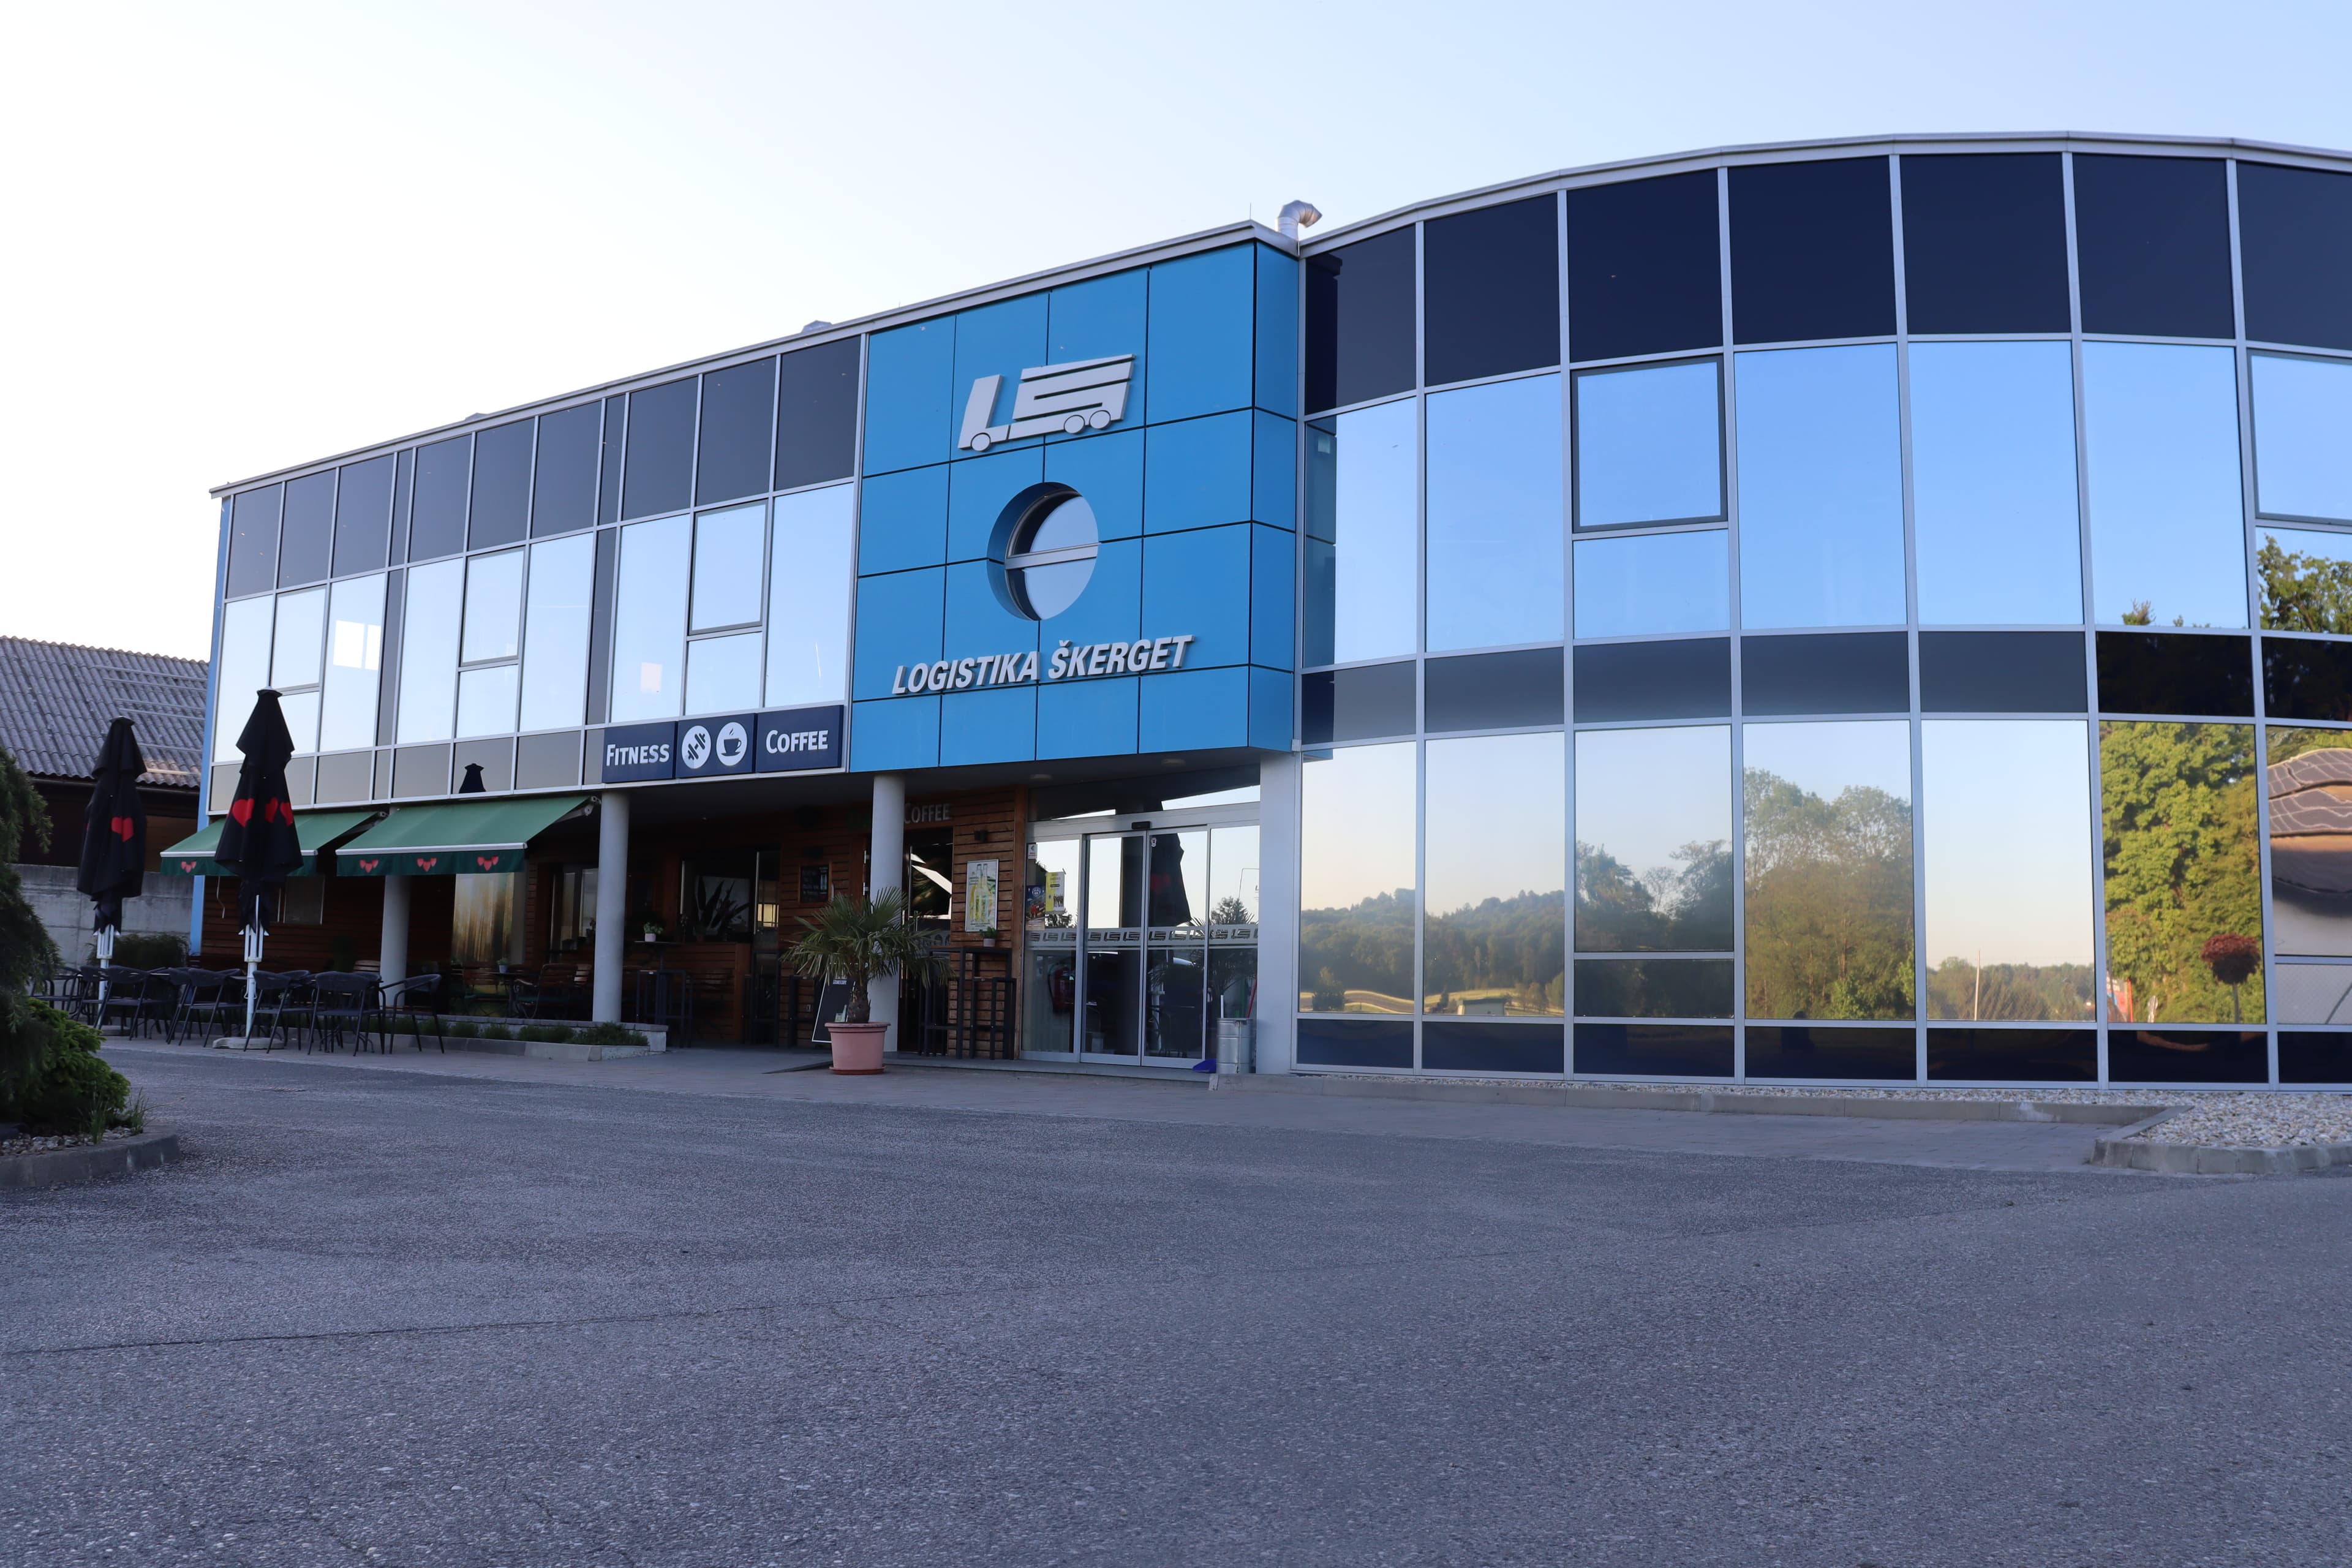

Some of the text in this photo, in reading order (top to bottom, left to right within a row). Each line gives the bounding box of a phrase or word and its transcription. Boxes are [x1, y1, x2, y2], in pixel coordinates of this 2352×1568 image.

[892, 635, 1194, 695] LOGISTIKA ŠKERGET
[606, 729, 829, 767] FITNESS COFFEE
